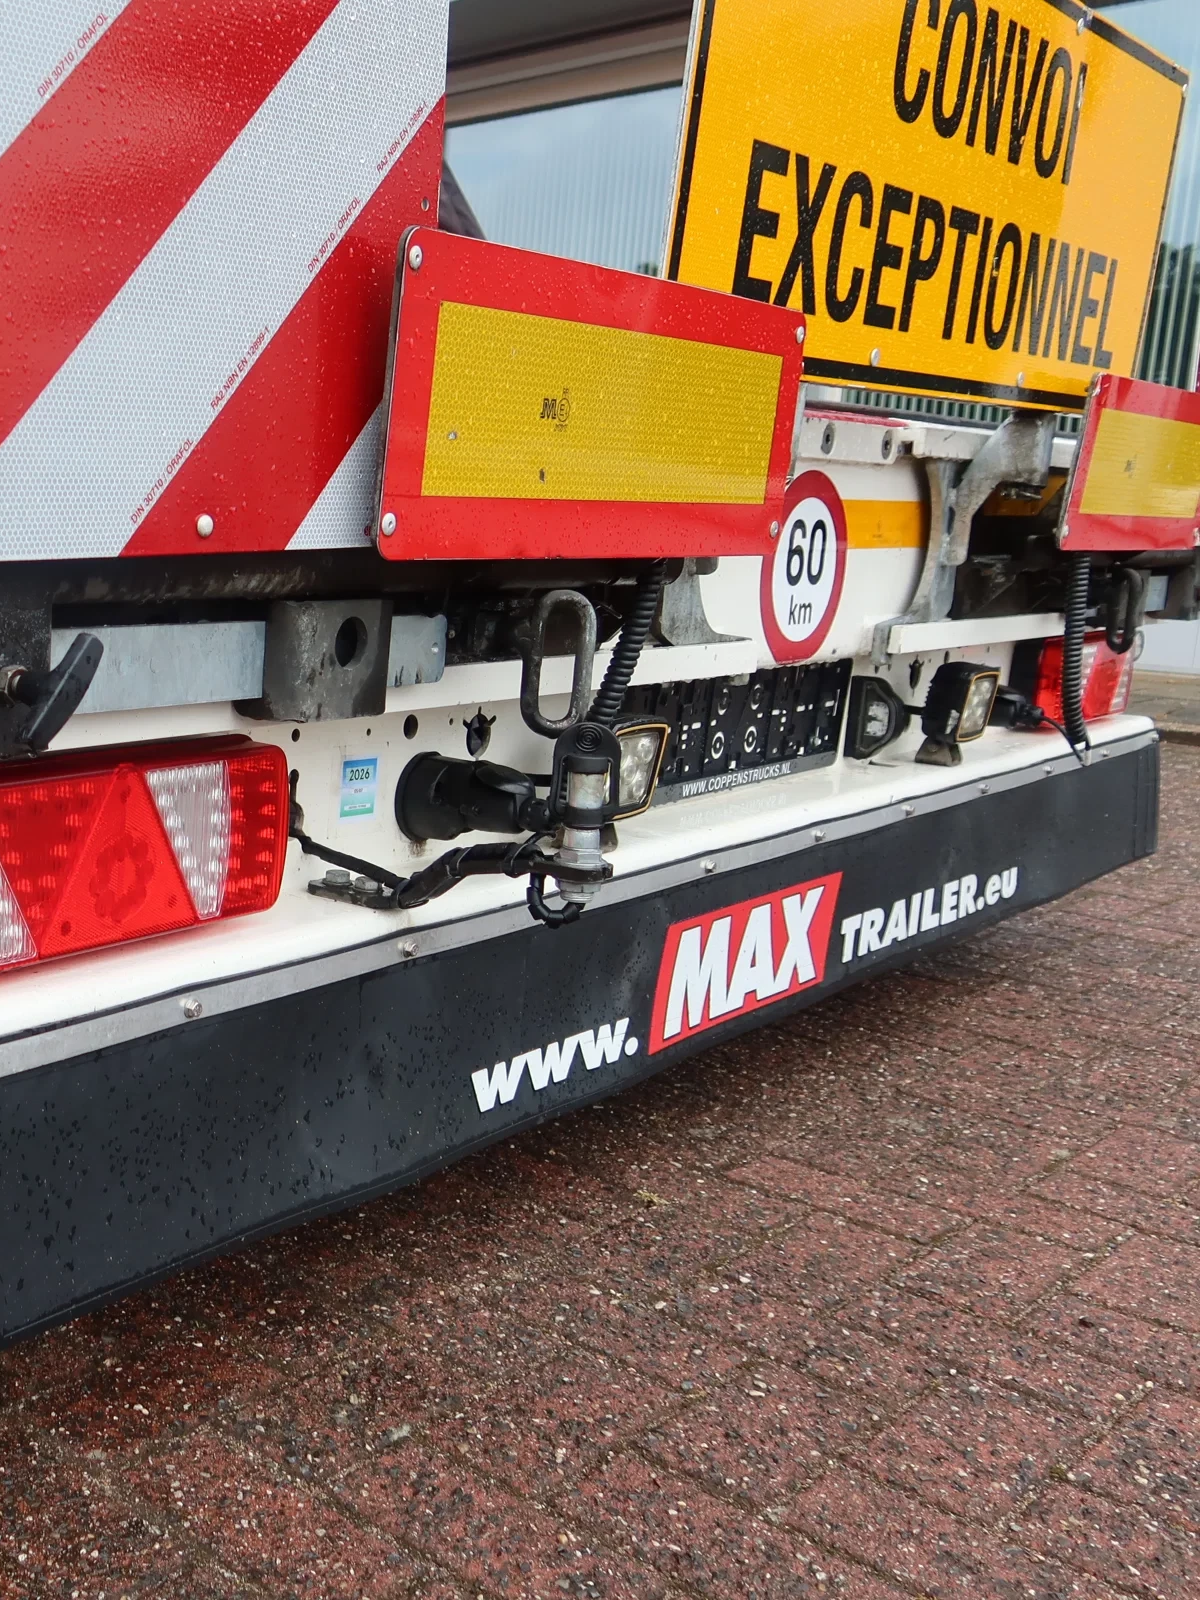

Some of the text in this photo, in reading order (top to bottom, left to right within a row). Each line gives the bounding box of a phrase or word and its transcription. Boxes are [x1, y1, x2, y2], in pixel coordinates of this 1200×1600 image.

[37, 77, 53, 98] DIN
[51, 51, 75, 80] 30710
[77, 12, 108, 49] ORAFOL
[893, 0, 1089, 185] CONVOI
[319, 232, 336, 257] 30710
[337, 197, 361, 230] ORAFOL
[732, 138, 1119, 370] EXCEPTIONNEL
[210, 390, 225, 410] RA2
[223, 369, 239, 392] NBN
[237, 356, 248, 372] EN
[130, 505, 145, 524] DIN
[143, 478, 164, 507] 30710
[166, 438, 194, 475] ORAFOL
[786, 519, 827, 586] 60
[788, 594, 812, 626] km
[349, 768, 370, 781] 2026
[682, 762, 792, 798] WWW.COPPENSTRUCKS.NL
[663, 886, 825, 1040] MAX
[840, 866, 1019, 963] TRAILER.eu
